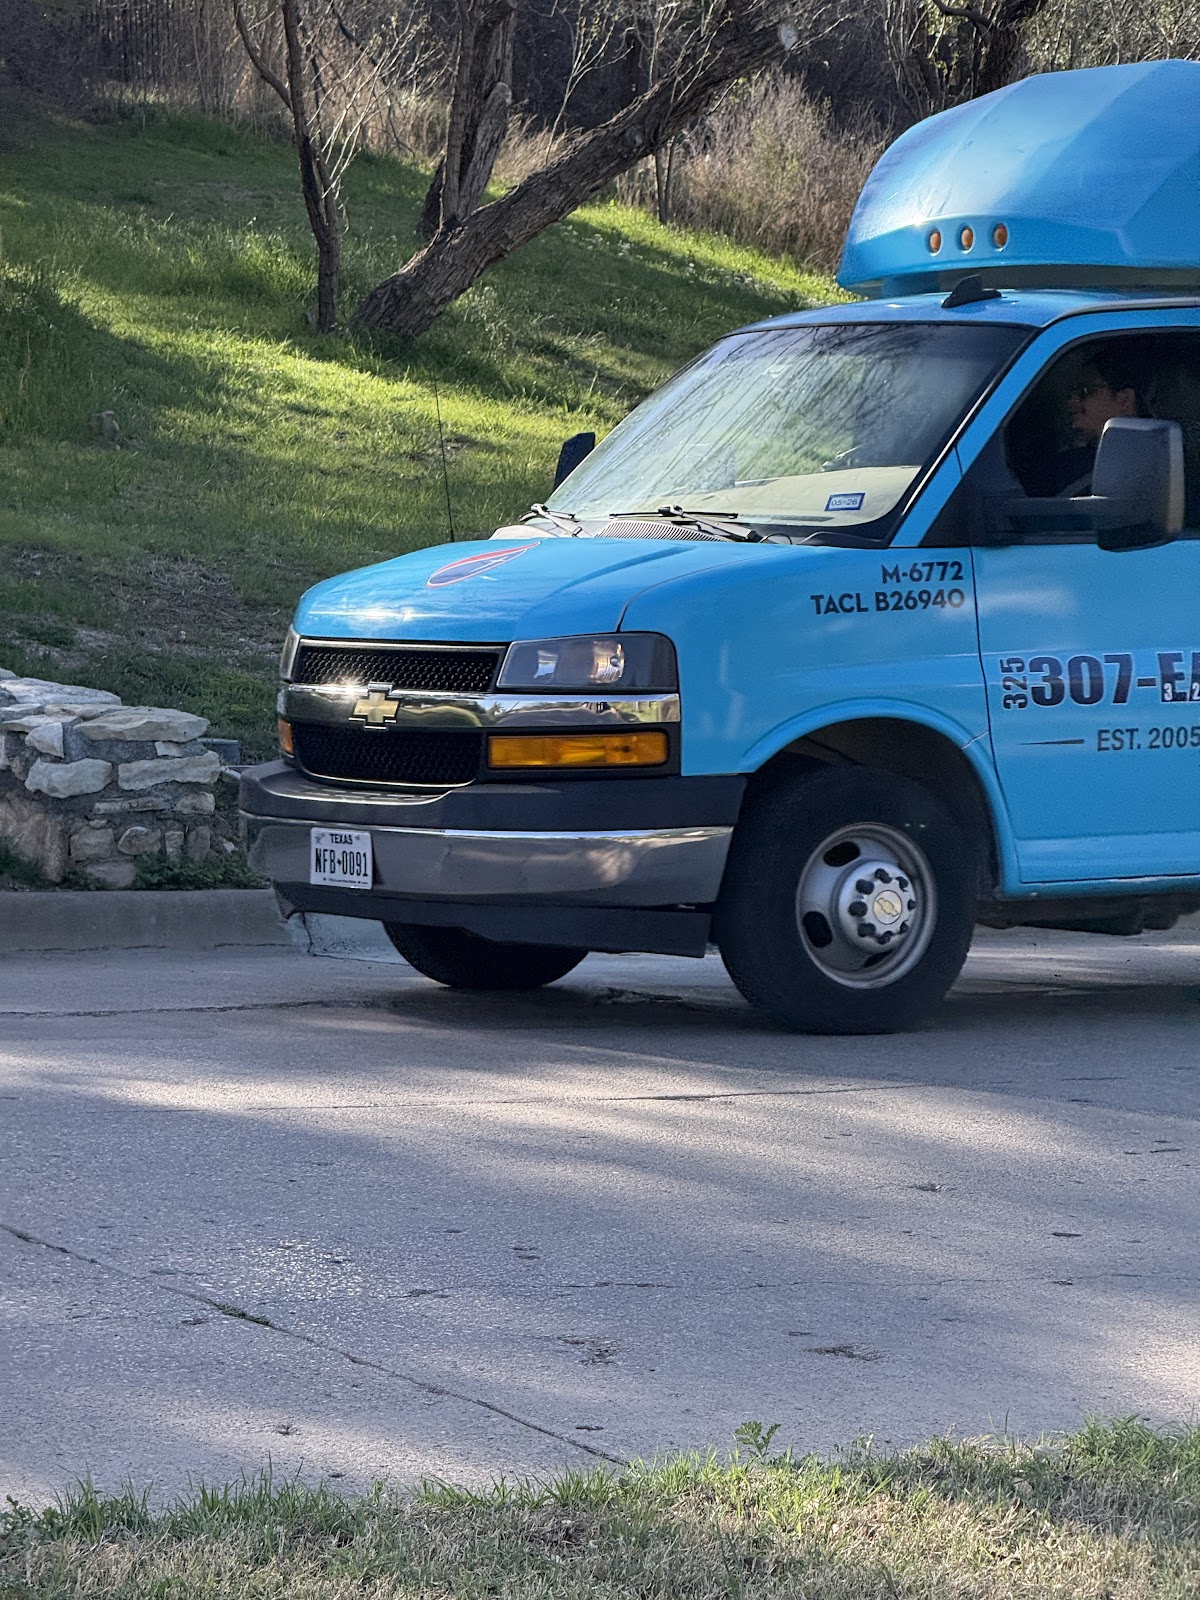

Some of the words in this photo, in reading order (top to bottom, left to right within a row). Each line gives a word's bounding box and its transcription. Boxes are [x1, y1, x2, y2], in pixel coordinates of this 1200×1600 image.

[881, 561, 964, 584] M-6772
[810, 593, 869, 615] TACL
[999, 657, 1028, 710] 325
[1097, 728, 1141, 751] EST.
[1148, 726, 1200, 749] 2005
[330, 833, 353, 844] TEXAS
